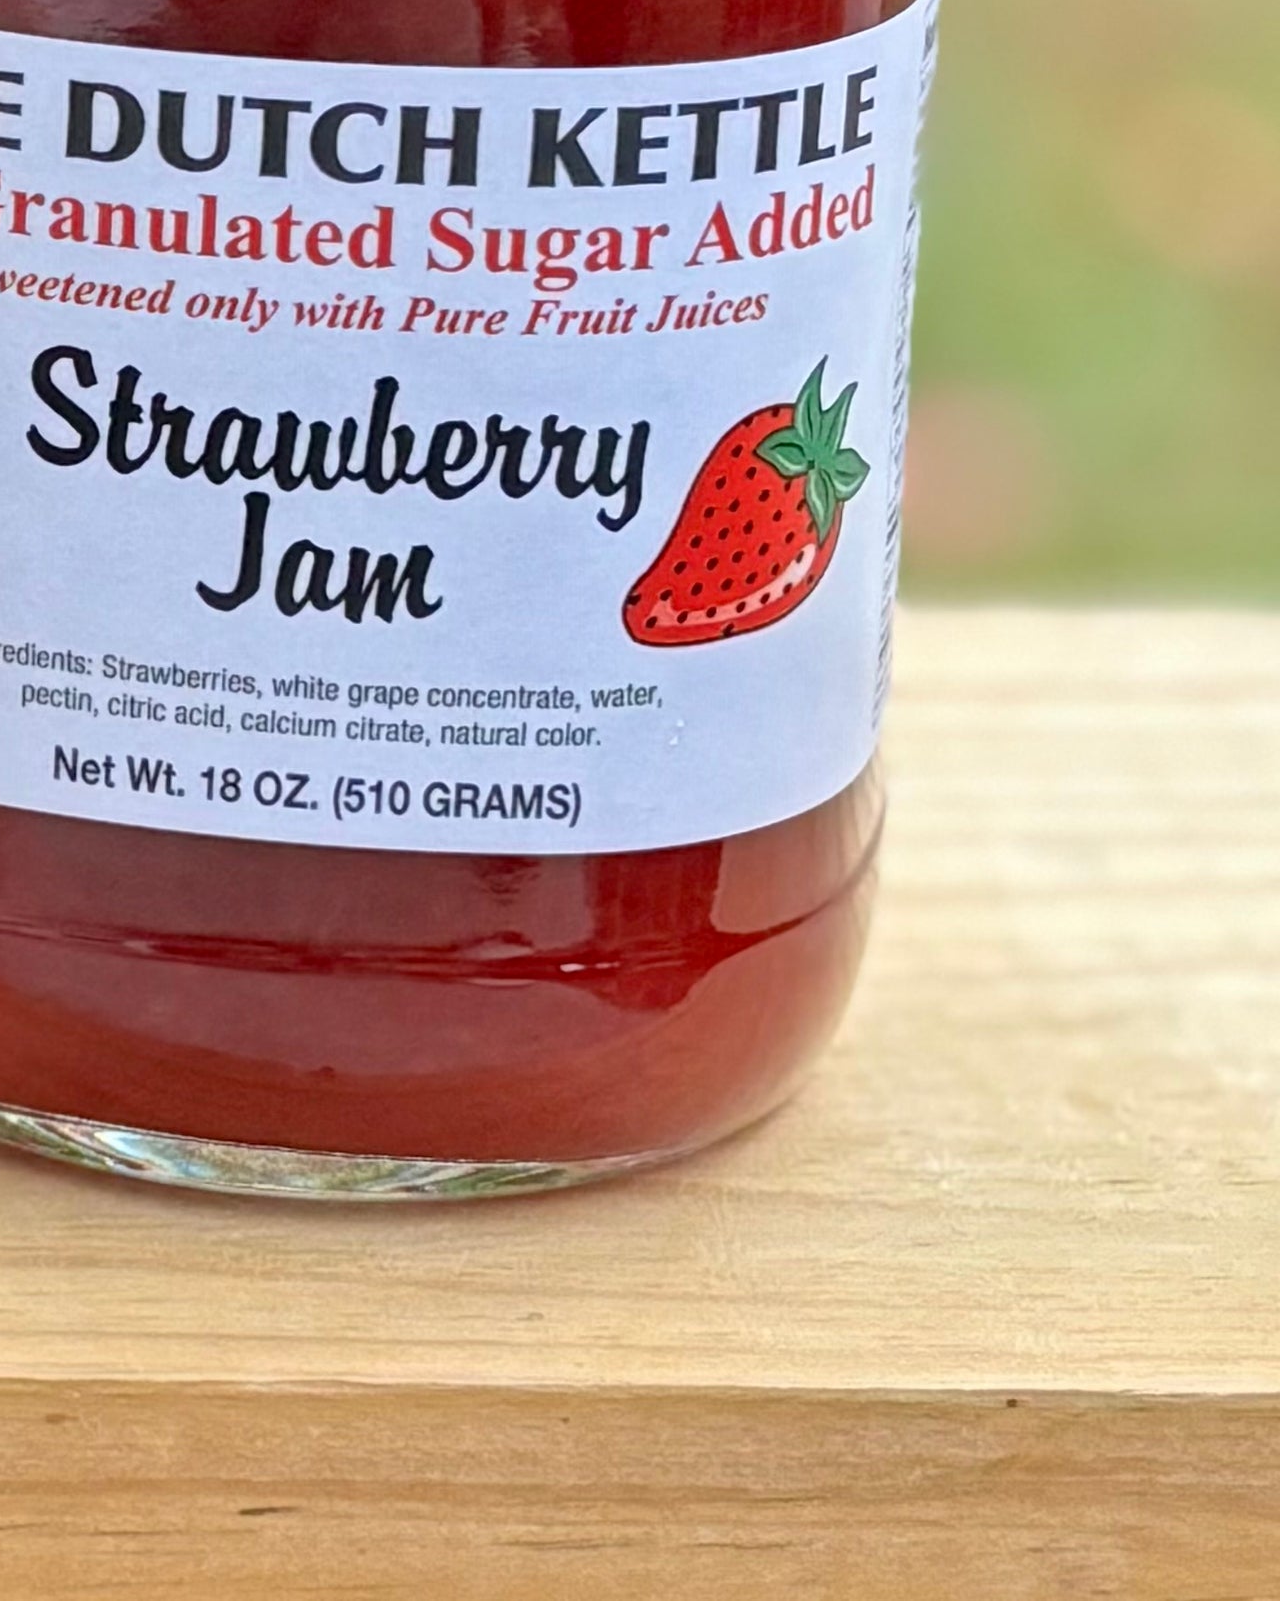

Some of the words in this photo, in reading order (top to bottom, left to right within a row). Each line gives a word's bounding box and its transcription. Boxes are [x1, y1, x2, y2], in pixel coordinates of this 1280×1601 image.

[66, 79, 483, 187] DUTCH
[528, 64, 878, 188] KETTLE
[426, 206, 671, 292] Sugar
[686, 163, 876, 266] Added
[186, 286, 279, 333] only
[292, 292, 384, 331] with
[399, 296, 509, 336] Pure
[520, 298, 638, 336] Fruit
[645, 290, 769, 335] Juices
[26, 345, 651, 532] Strawberry
[195, 492, 444, 624] Jam
[21, 682, 99, 718] pectin,
[107, 693, 166, 722] citric
[174, 703, 232, 733] acid,
[240, 709, 337, 739] calcium
[345, 716, 431, 747] citrate,
[440, 721, 527, 746] natural
[535, 722, 602, 747] color.
[102, 654, 263, 700] Strawberries,
[272, 675, 340, 702] white
[347, 682, 420, 711] grape
[426, 684, 582, 713] concentrate,
[590, 682, 663, 709] water,
[53, 744, 115, 789] Net
[126, 755, 185, 797] Wt.
[201, 766, 242, 803] 18
[253, 770, 319, 811] OZ.
[333, 776, 411, 820] (510
[422, 781, 582, 829] GRAMS)
